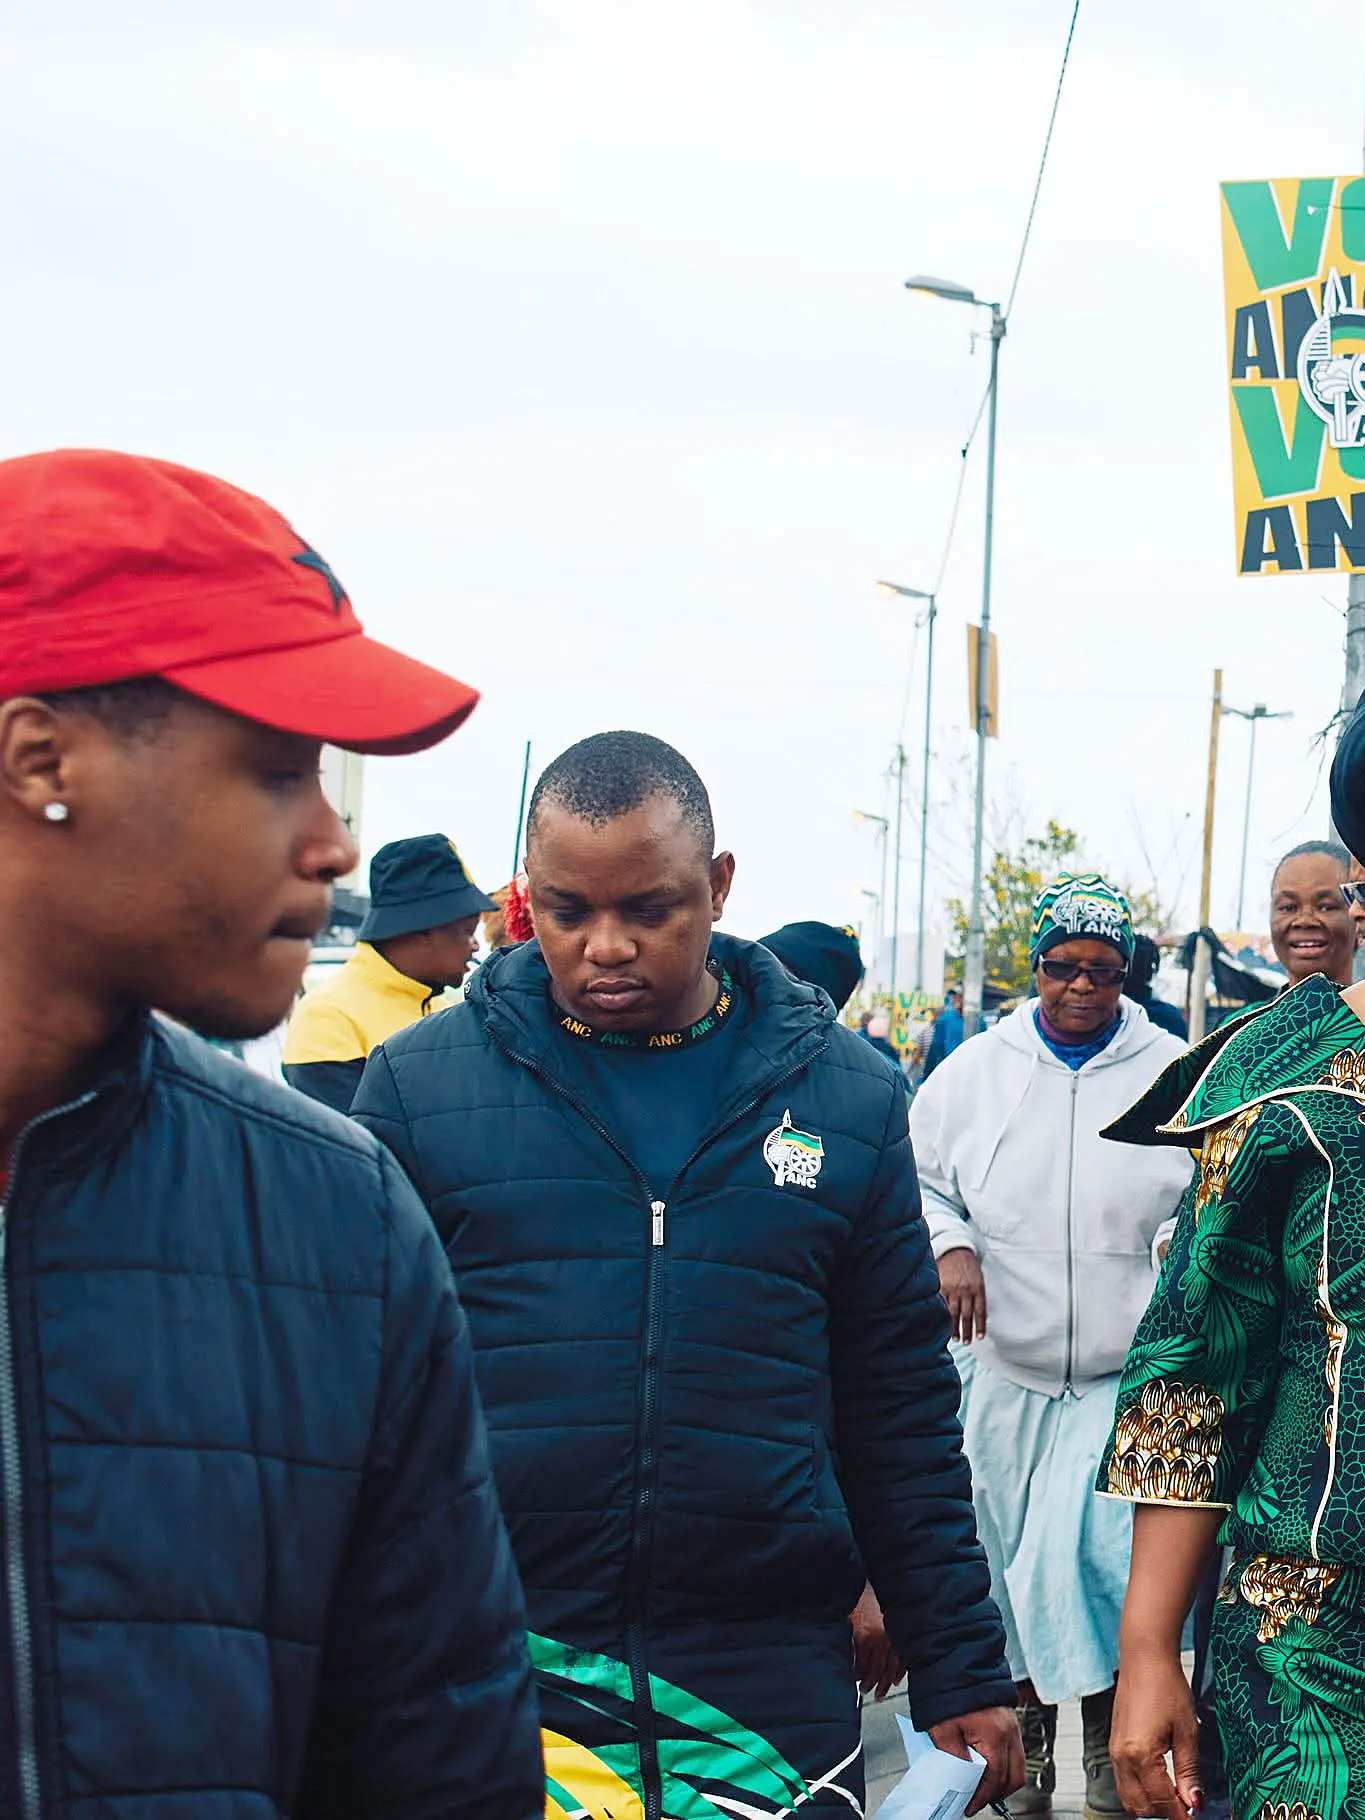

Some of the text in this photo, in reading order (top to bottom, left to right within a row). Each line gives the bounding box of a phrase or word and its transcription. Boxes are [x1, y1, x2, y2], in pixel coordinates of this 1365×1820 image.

[1084, 921, 1121, 941] ANC
[716, 992, 731, 1017] ANC
[560, 1016, 592, 1037] ANC
[691, 1016, 716, 1038] ANC
[648, 1032, 682, 1047] ANC
[786, 1173, 817, 1189] ANC
